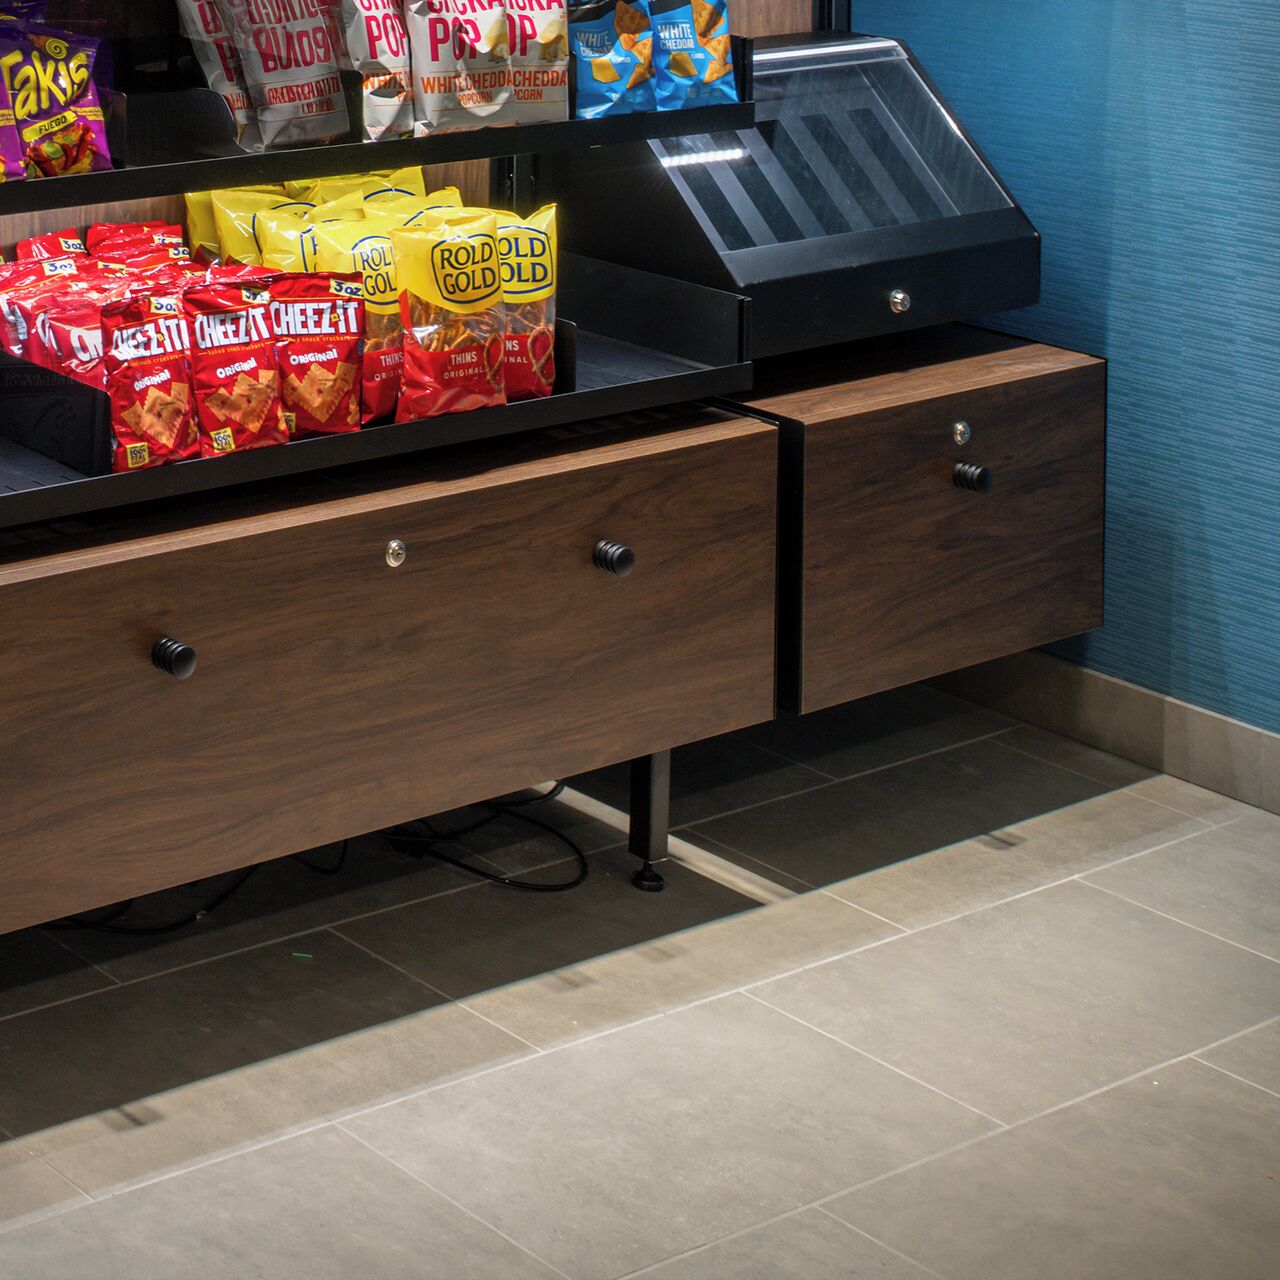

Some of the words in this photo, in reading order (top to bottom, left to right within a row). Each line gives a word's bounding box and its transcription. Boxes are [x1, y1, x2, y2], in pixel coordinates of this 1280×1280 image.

[658, 23, 694, 39] WHITE
[427, 16, 482, 63] POP
[660, 38, 695, 49] CHEDDAR
[458, 90, 493, 106] POPCORN
[38, 115, 68, 135] FUEGO
[440, 243, 494, 270] ROLD
[442, 269, 498, 296] GOLD
[450, 351, 478, 365] THINS
[443, 366, 484, 381] ORIGINAL
